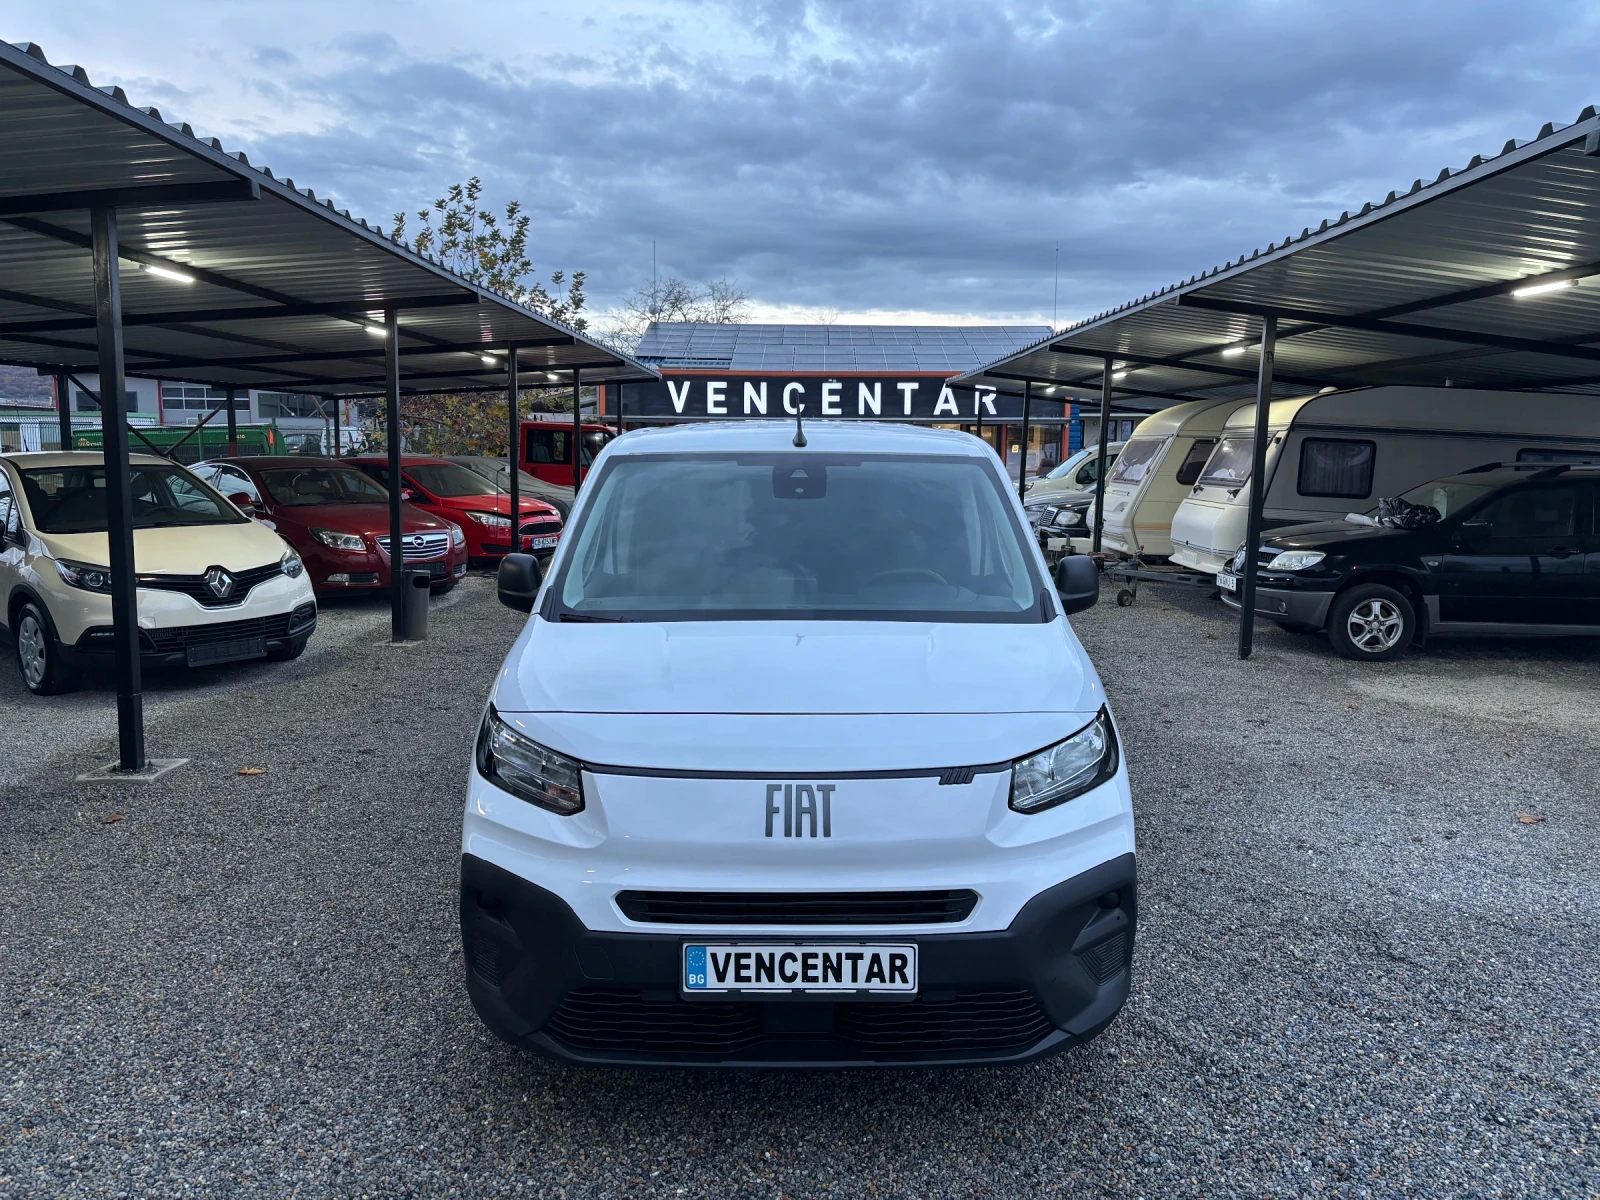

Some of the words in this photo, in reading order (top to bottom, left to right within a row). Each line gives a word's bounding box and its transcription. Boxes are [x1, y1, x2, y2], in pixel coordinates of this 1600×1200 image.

[667, 381, 997, 415] VENCENTAR
[765, 784, 836, 838] FIAT
[689, 974, 704, 984] BG
[710, 952, 909, 984] VENCENTAR
